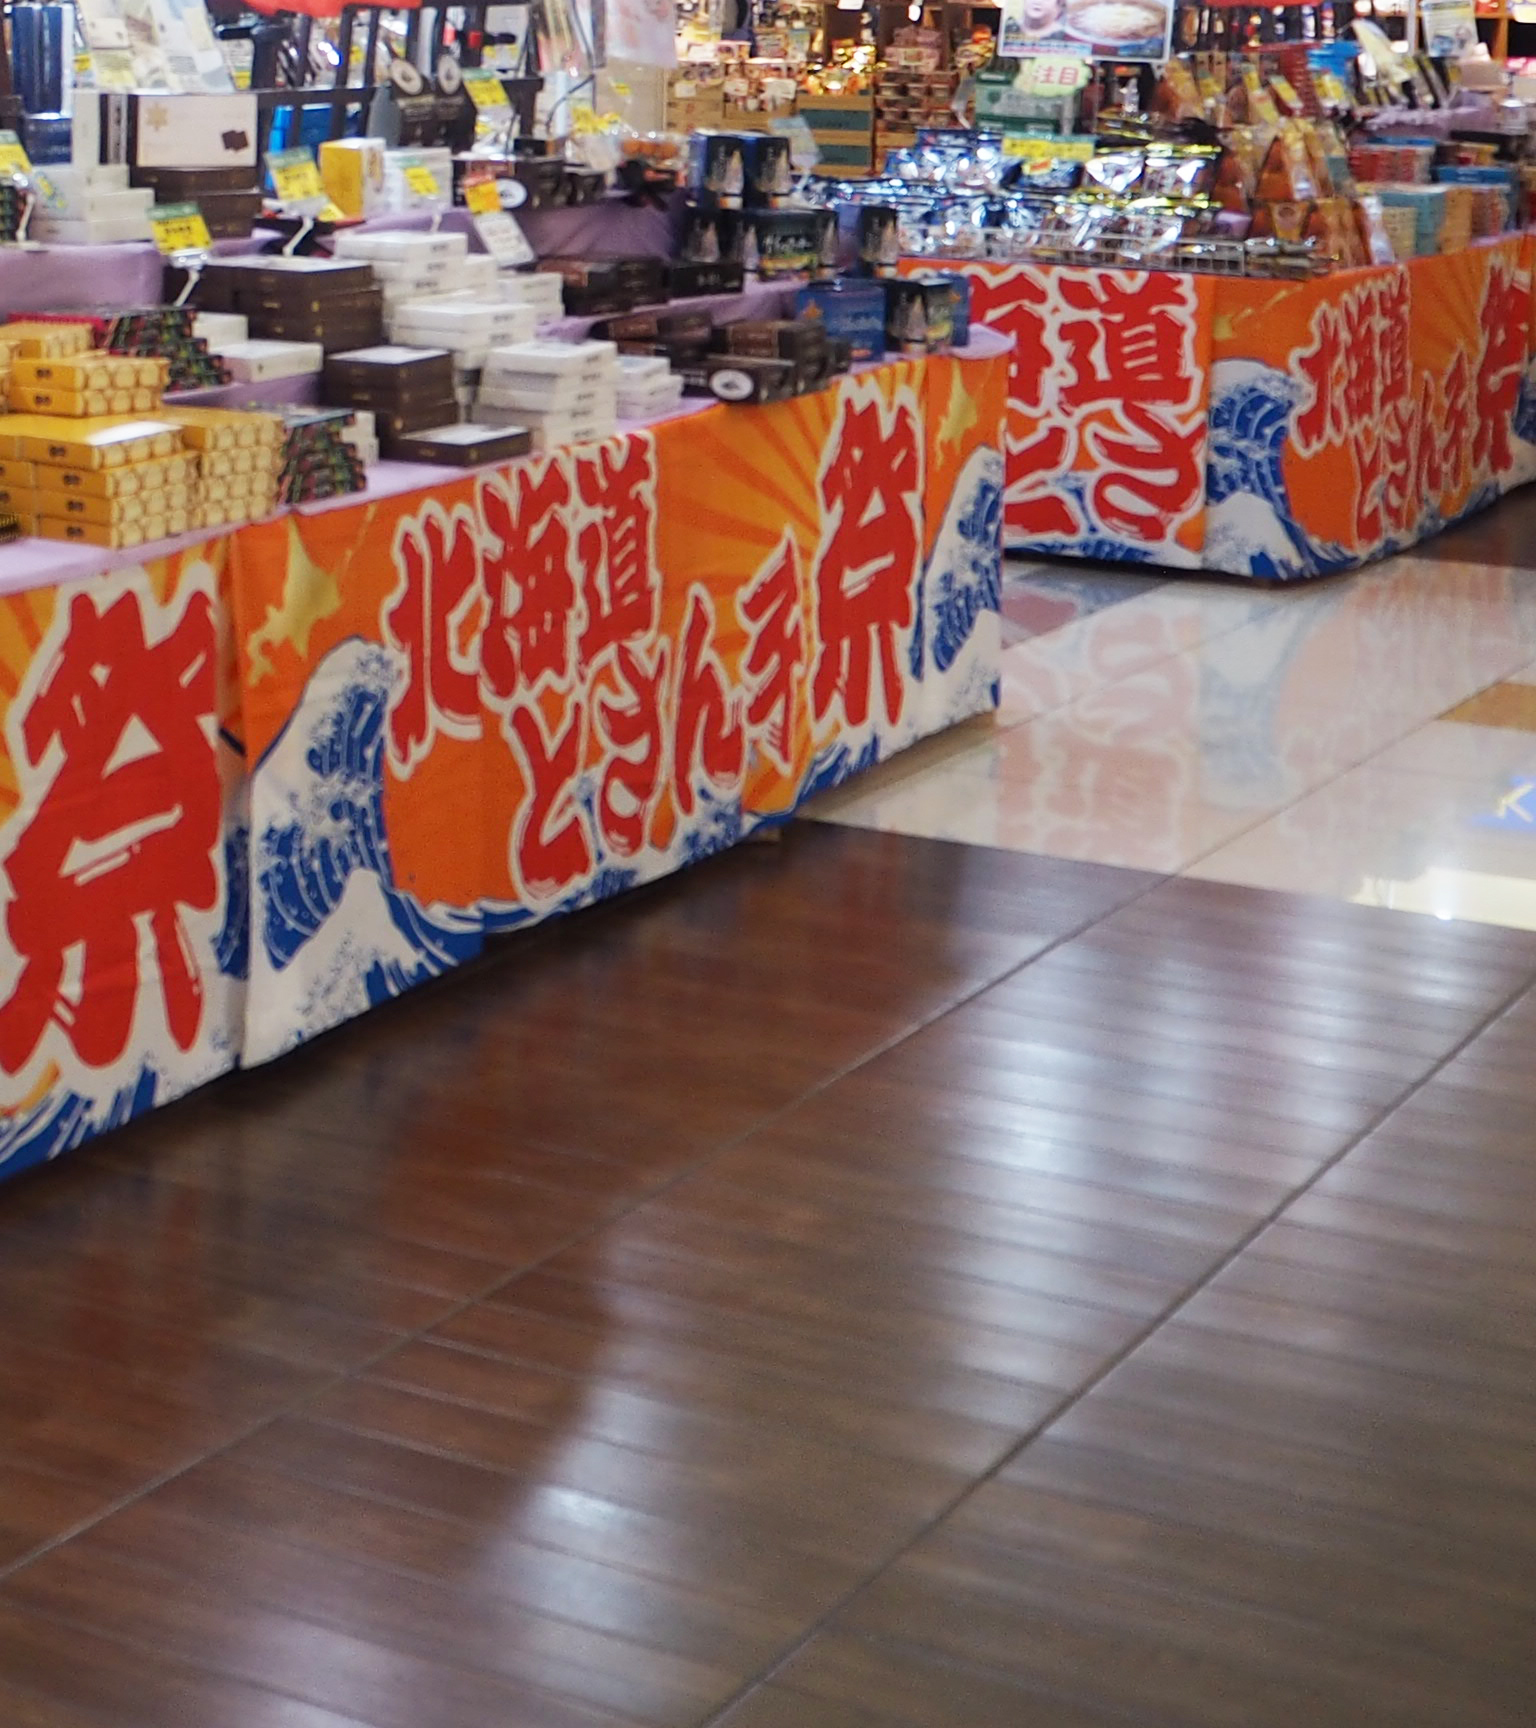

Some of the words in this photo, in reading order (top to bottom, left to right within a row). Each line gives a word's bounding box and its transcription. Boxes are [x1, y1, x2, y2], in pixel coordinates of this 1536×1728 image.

[1035, 65, 1079, 86] 注目
[1286, 262, 1411, 458] 北海道
[380, 429, 664, 779] 北海道
[506, 524, 812, 900] どさん子
[809, 376, 926, 737] 祭
